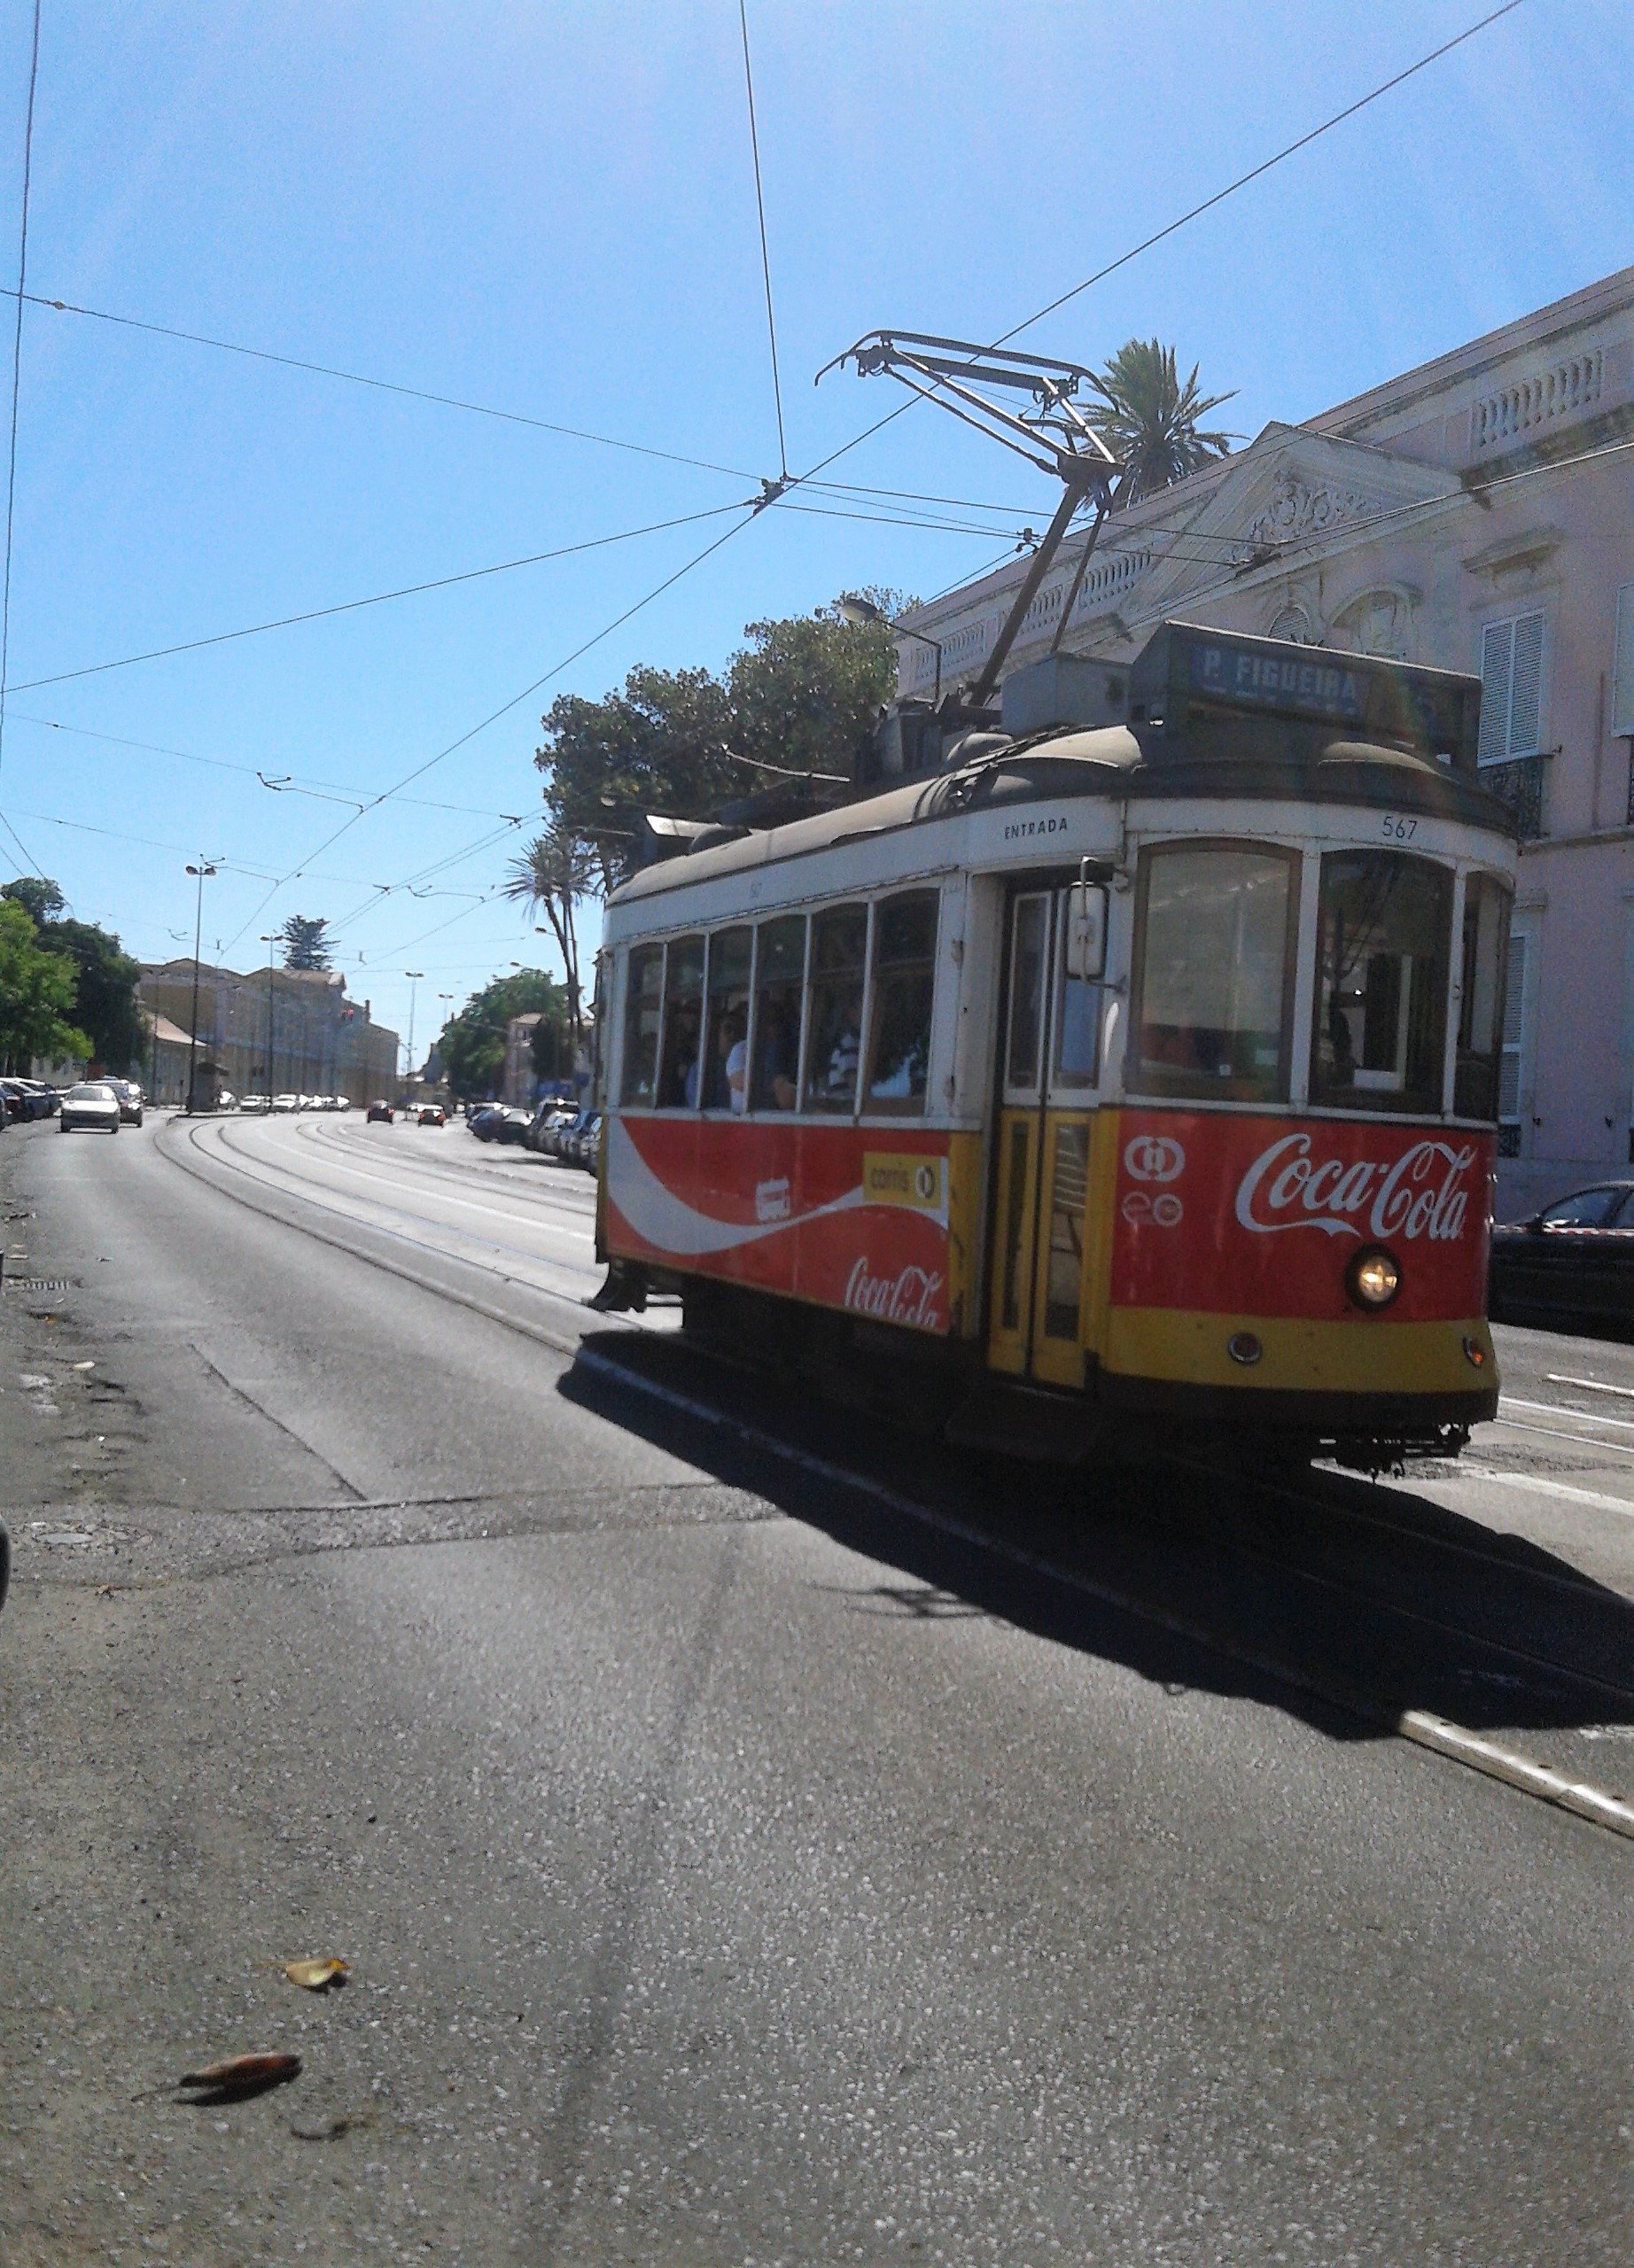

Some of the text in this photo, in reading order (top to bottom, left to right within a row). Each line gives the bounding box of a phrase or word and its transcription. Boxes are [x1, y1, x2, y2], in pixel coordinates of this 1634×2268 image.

[1236, 656, 1358, 699] FIGUEIRA
[1004, 818, 1067, 840] ENTRADA
[1382, 816, 1418, 840] 567
[1235, 1133, 1478, 1239] Coca-Cola
